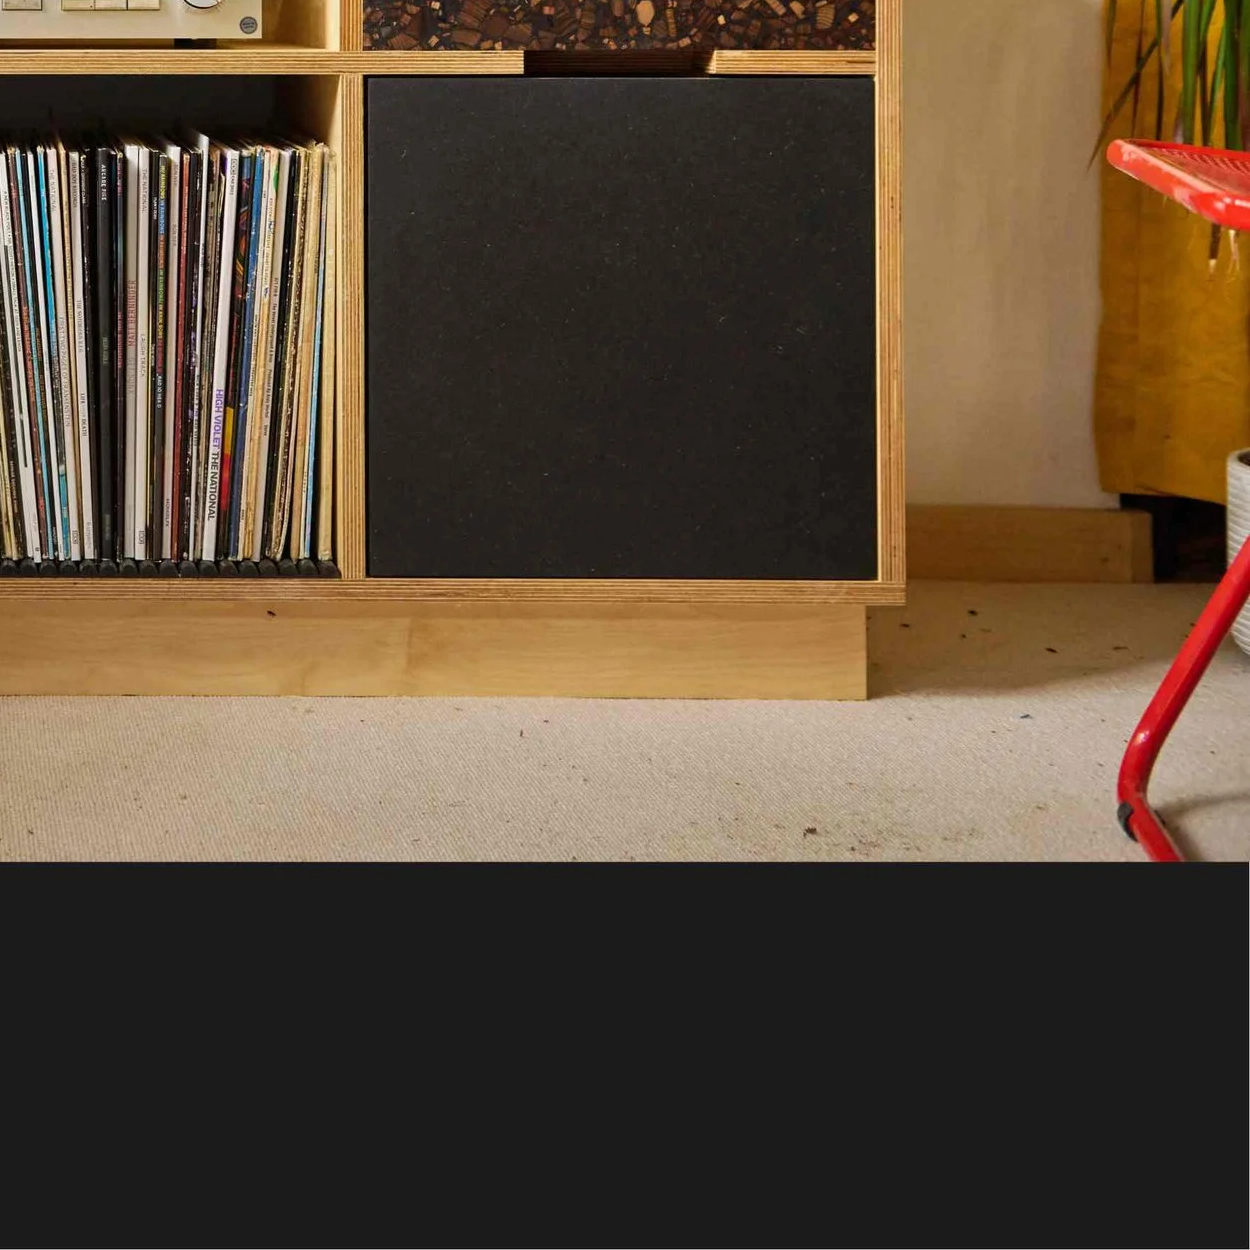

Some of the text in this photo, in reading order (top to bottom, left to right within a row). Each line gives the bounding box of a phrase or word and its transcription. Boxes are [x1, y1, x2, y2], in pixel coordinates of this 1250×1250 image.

[127, 280, 136, 347] MATT BERNINGER
[63, 381, 71, 427] FRANKENSTEIN
[215, 389, 224, 413] HIGH
[212, 415, 222, 449] VIOLET
[211, 452, 220, 469] THE
[208, 472, 219, 521] NATIONAL
